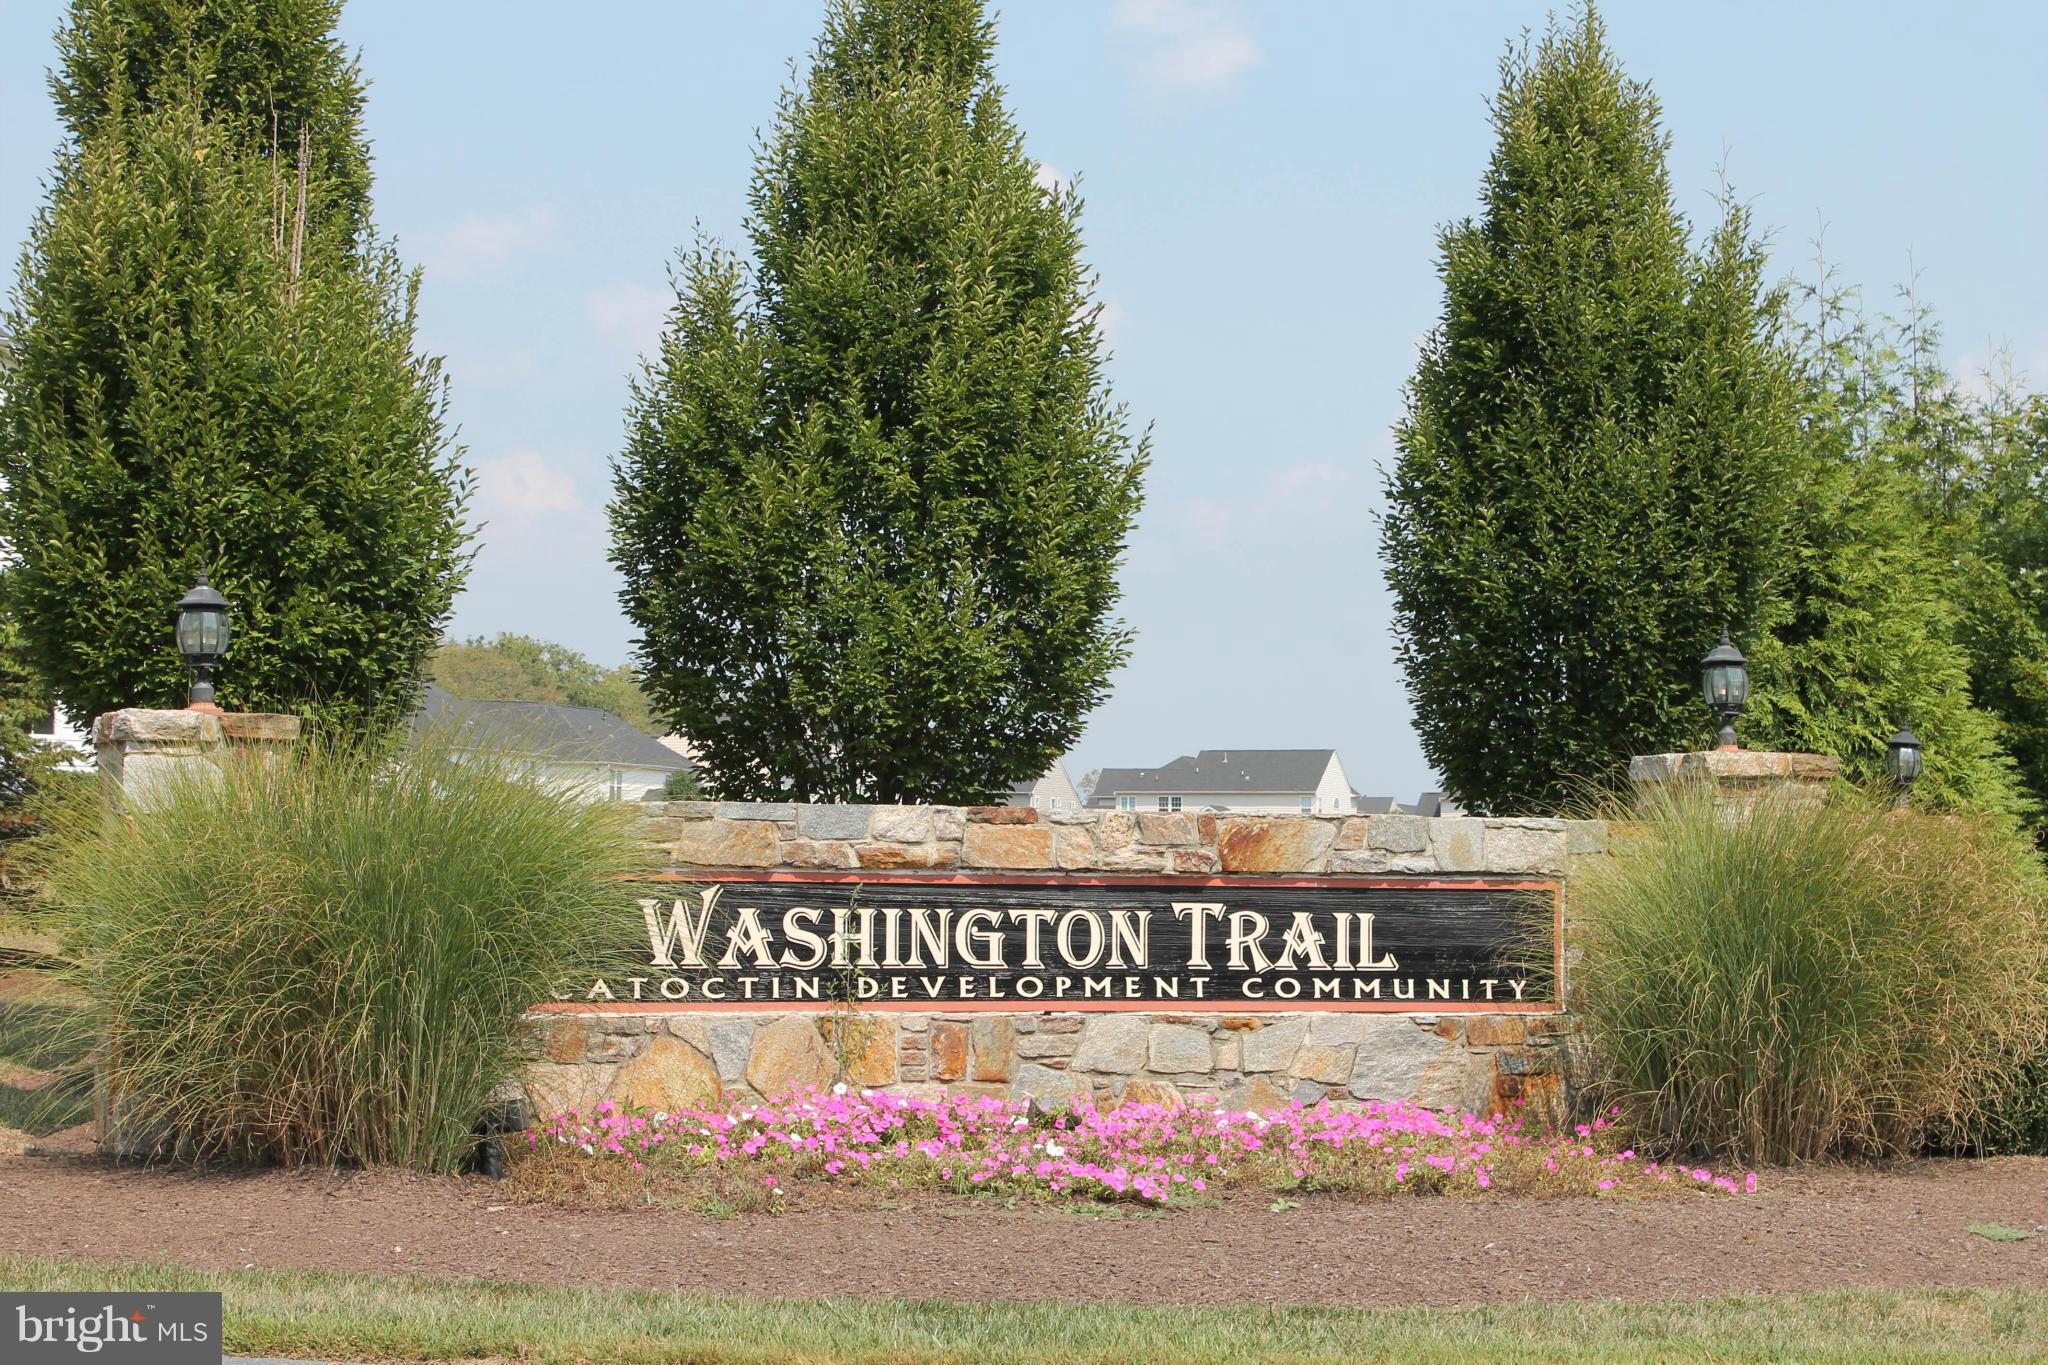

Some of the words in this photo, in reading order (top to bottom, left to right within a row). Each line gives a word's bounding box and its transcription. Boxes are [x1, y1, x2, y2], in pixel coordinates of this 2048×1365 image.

[638, 884, 1152, 970] WASHINGTON
[1171, 902, 1399, 974] TRAIL
[857, 976, 1210, 998] DEVELOPMENT
[1242, 977, 1527, 999] COMMUNITY
